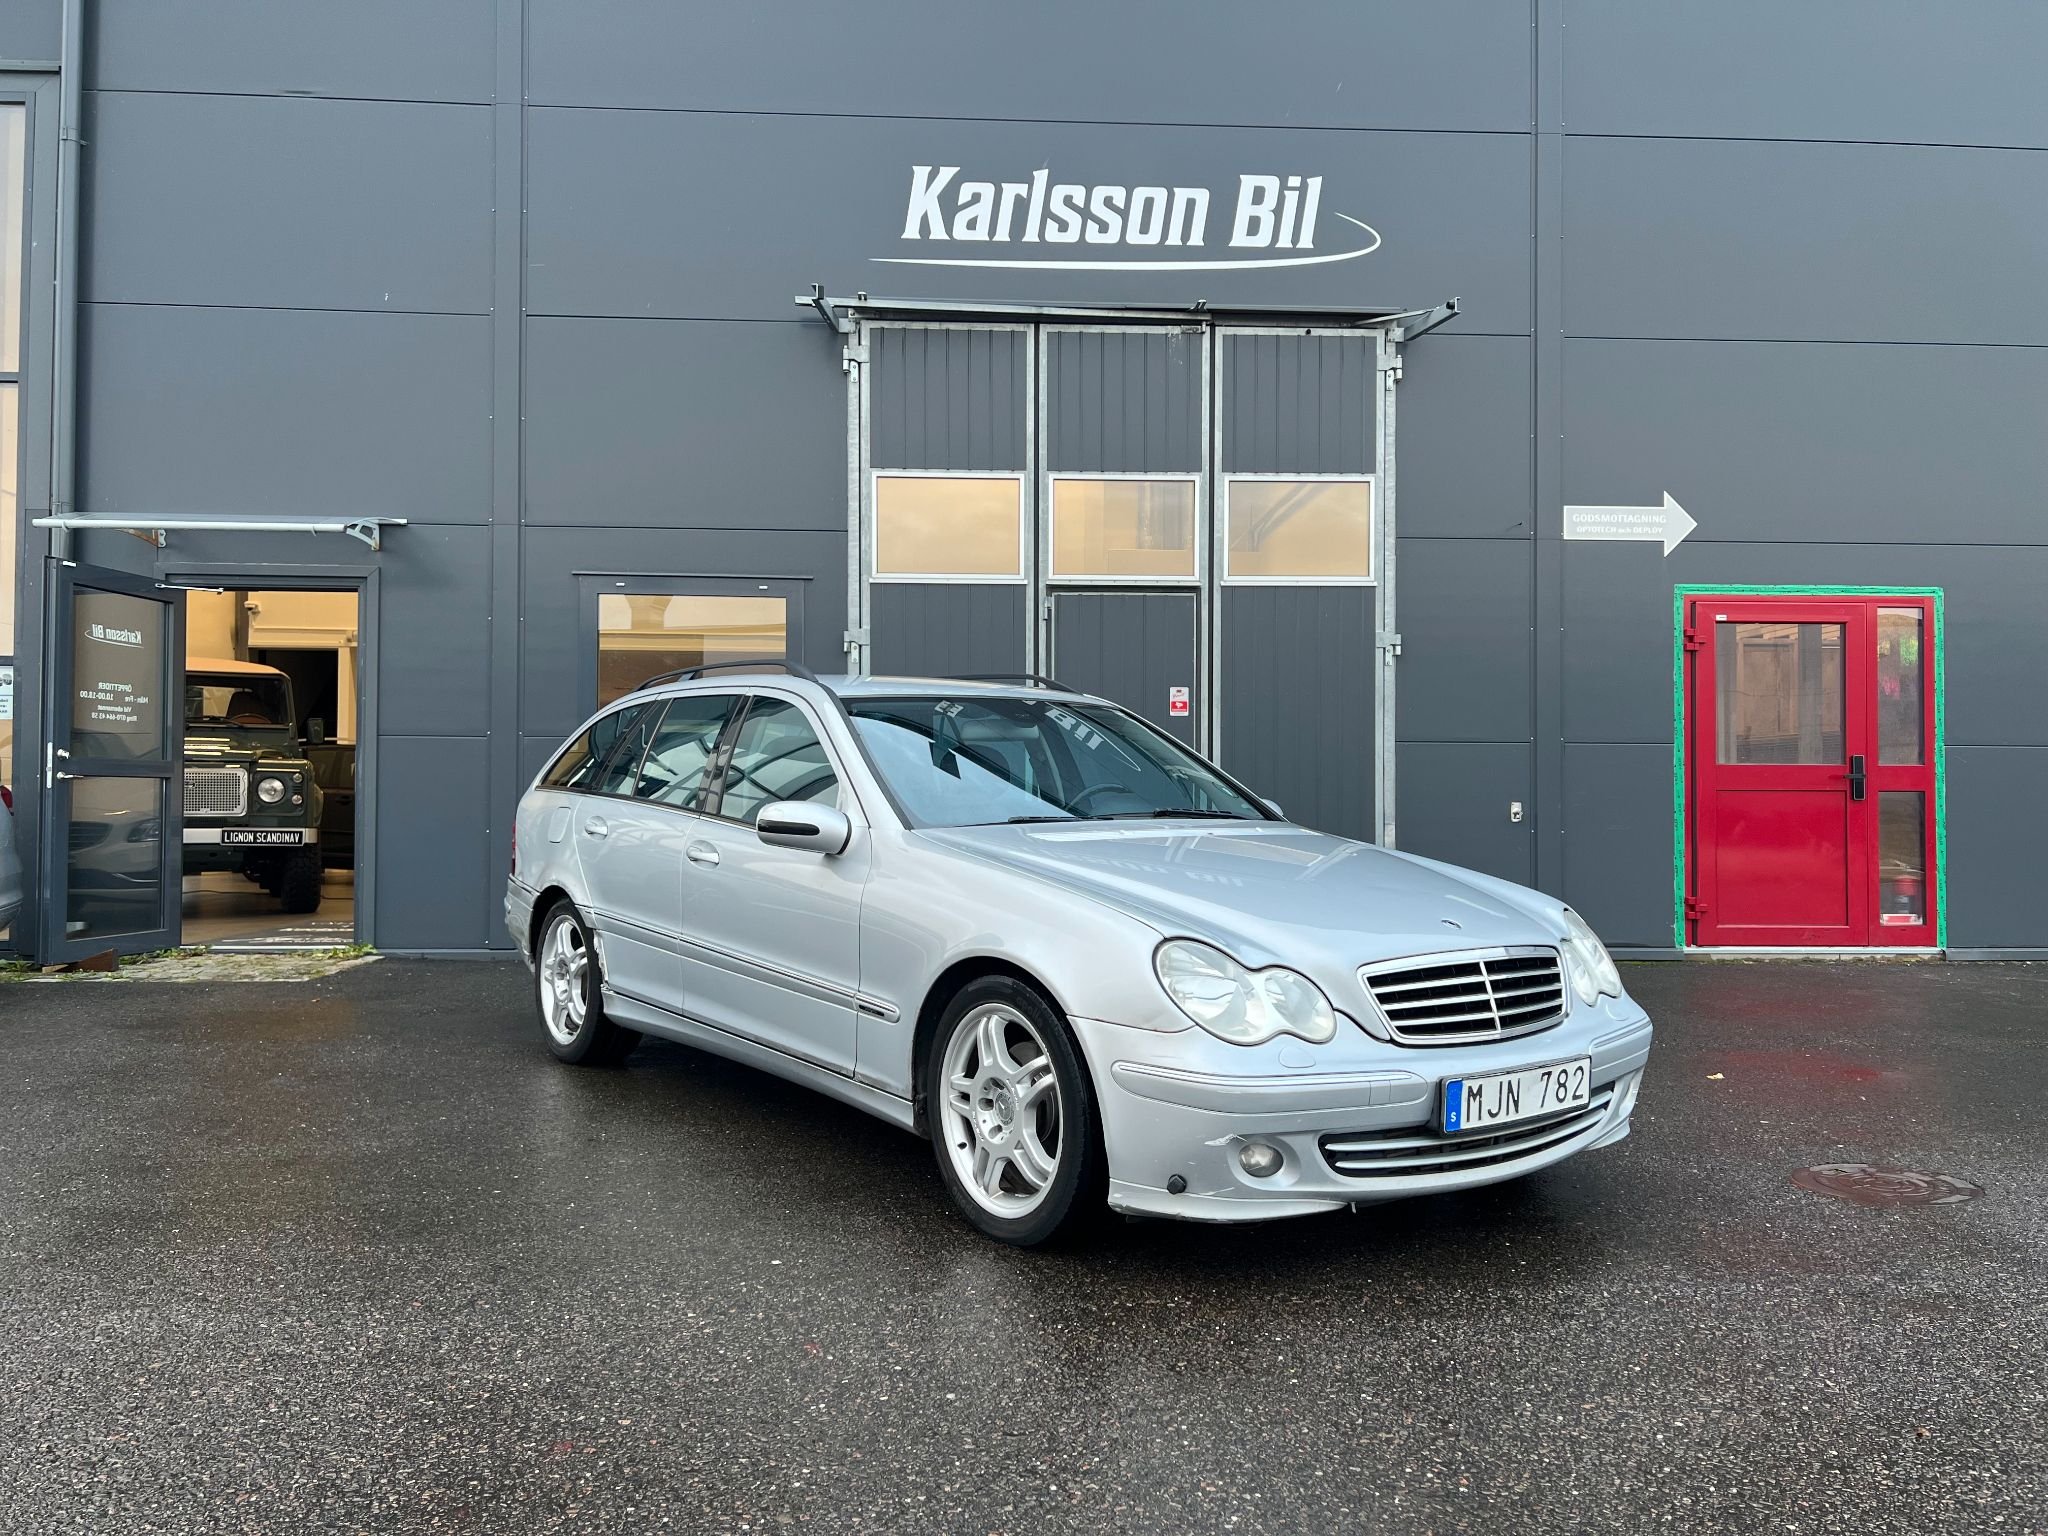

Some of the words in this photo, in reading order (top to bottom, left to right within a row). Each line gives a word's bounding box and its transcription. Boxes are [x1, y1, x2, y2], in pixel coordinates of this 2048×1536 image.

[901, 165, 1210, 246] Karlsson
[1228, 174, 1322, 249] Bil
[1572, 513, 1666, 523] GODSMOTTAGNING
[1633, 526, 1663, 534] DEPLOY
[224, 831, 254, 843] LIGNON
[1450, 1111, 1457, 1122] S
[1466, 1077, 1520, 1122] MJN
[1540, 1065, 1584, 1108] 782
